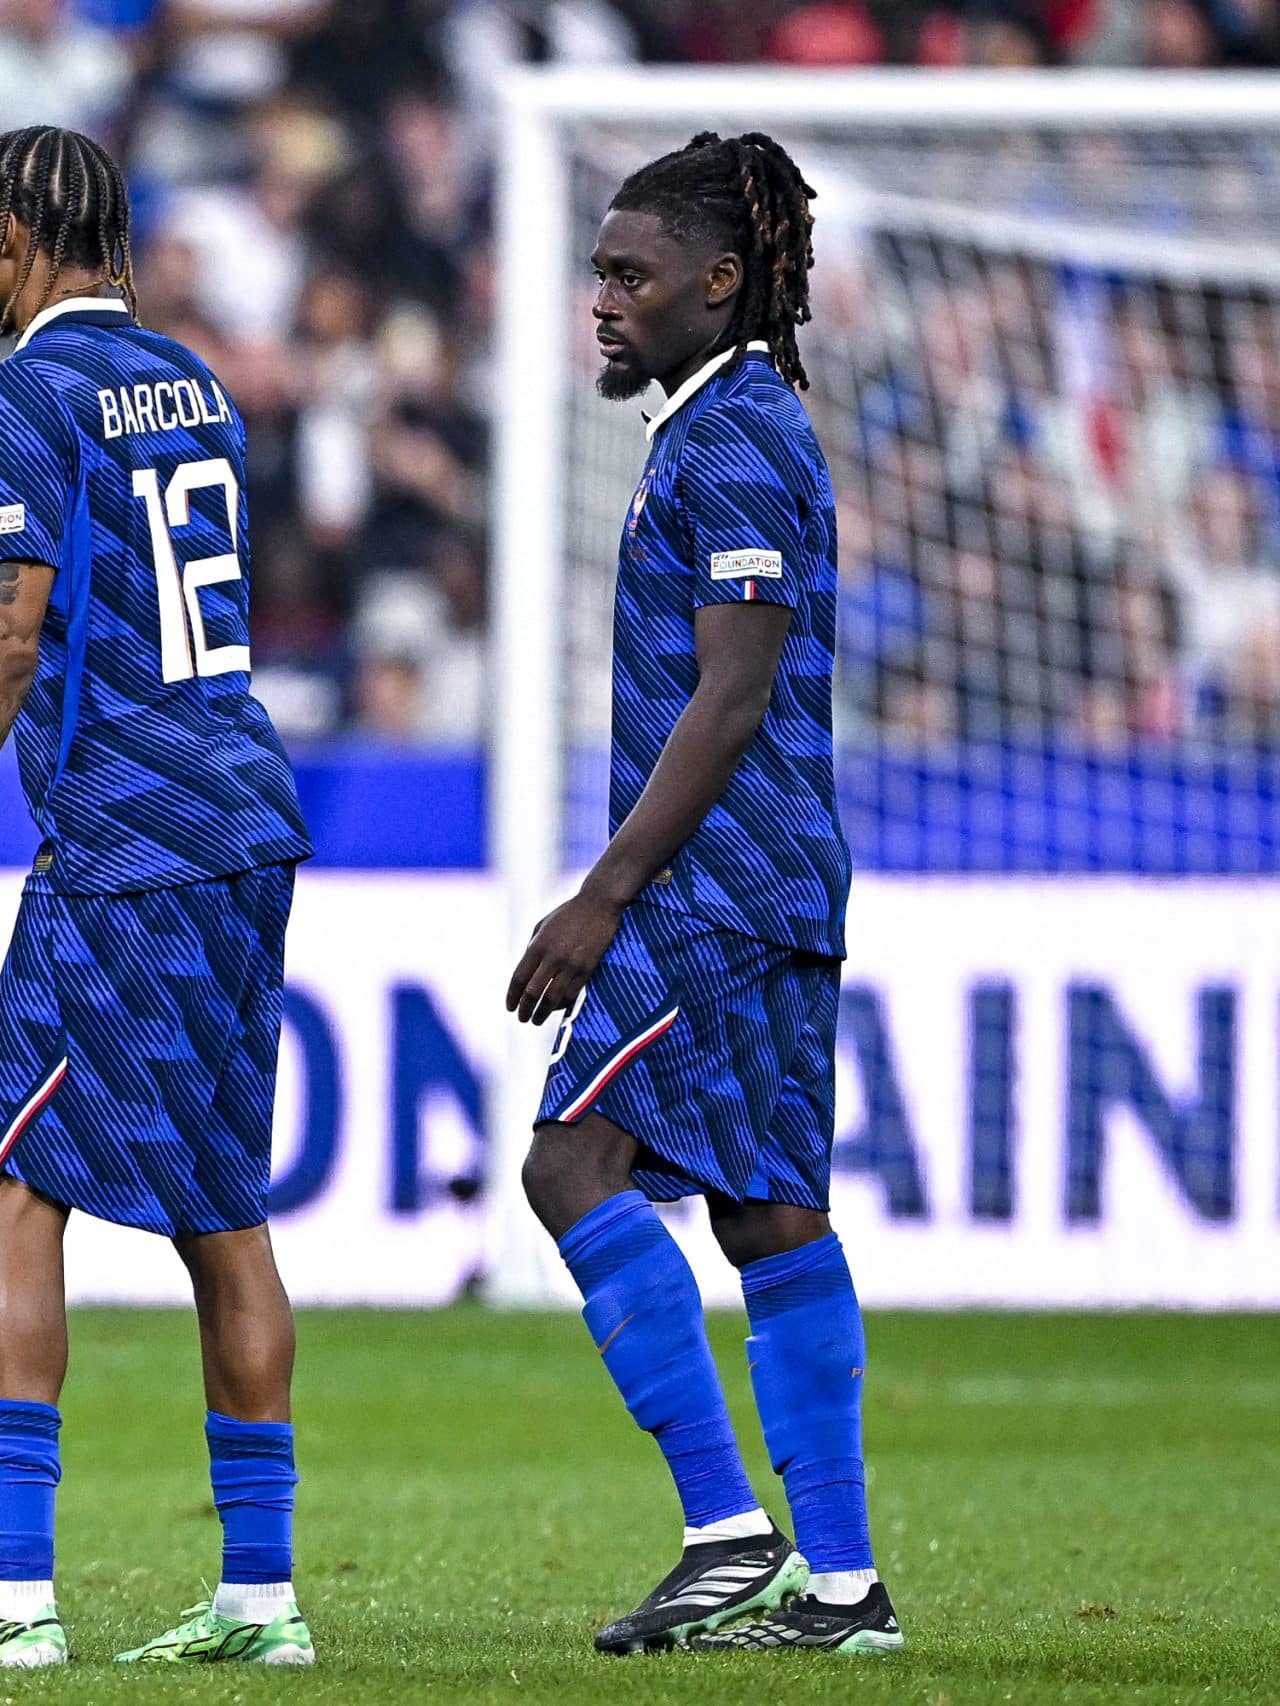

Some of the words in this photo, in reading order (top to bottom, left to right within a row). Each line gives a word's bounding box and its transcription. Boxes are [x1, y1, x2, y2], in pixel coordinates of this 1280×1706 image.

[98, 378, 233, 440] BARCOLA
[132, 458, 251, 684] 12
[713, 557, 780, 570] FOUNDATION
